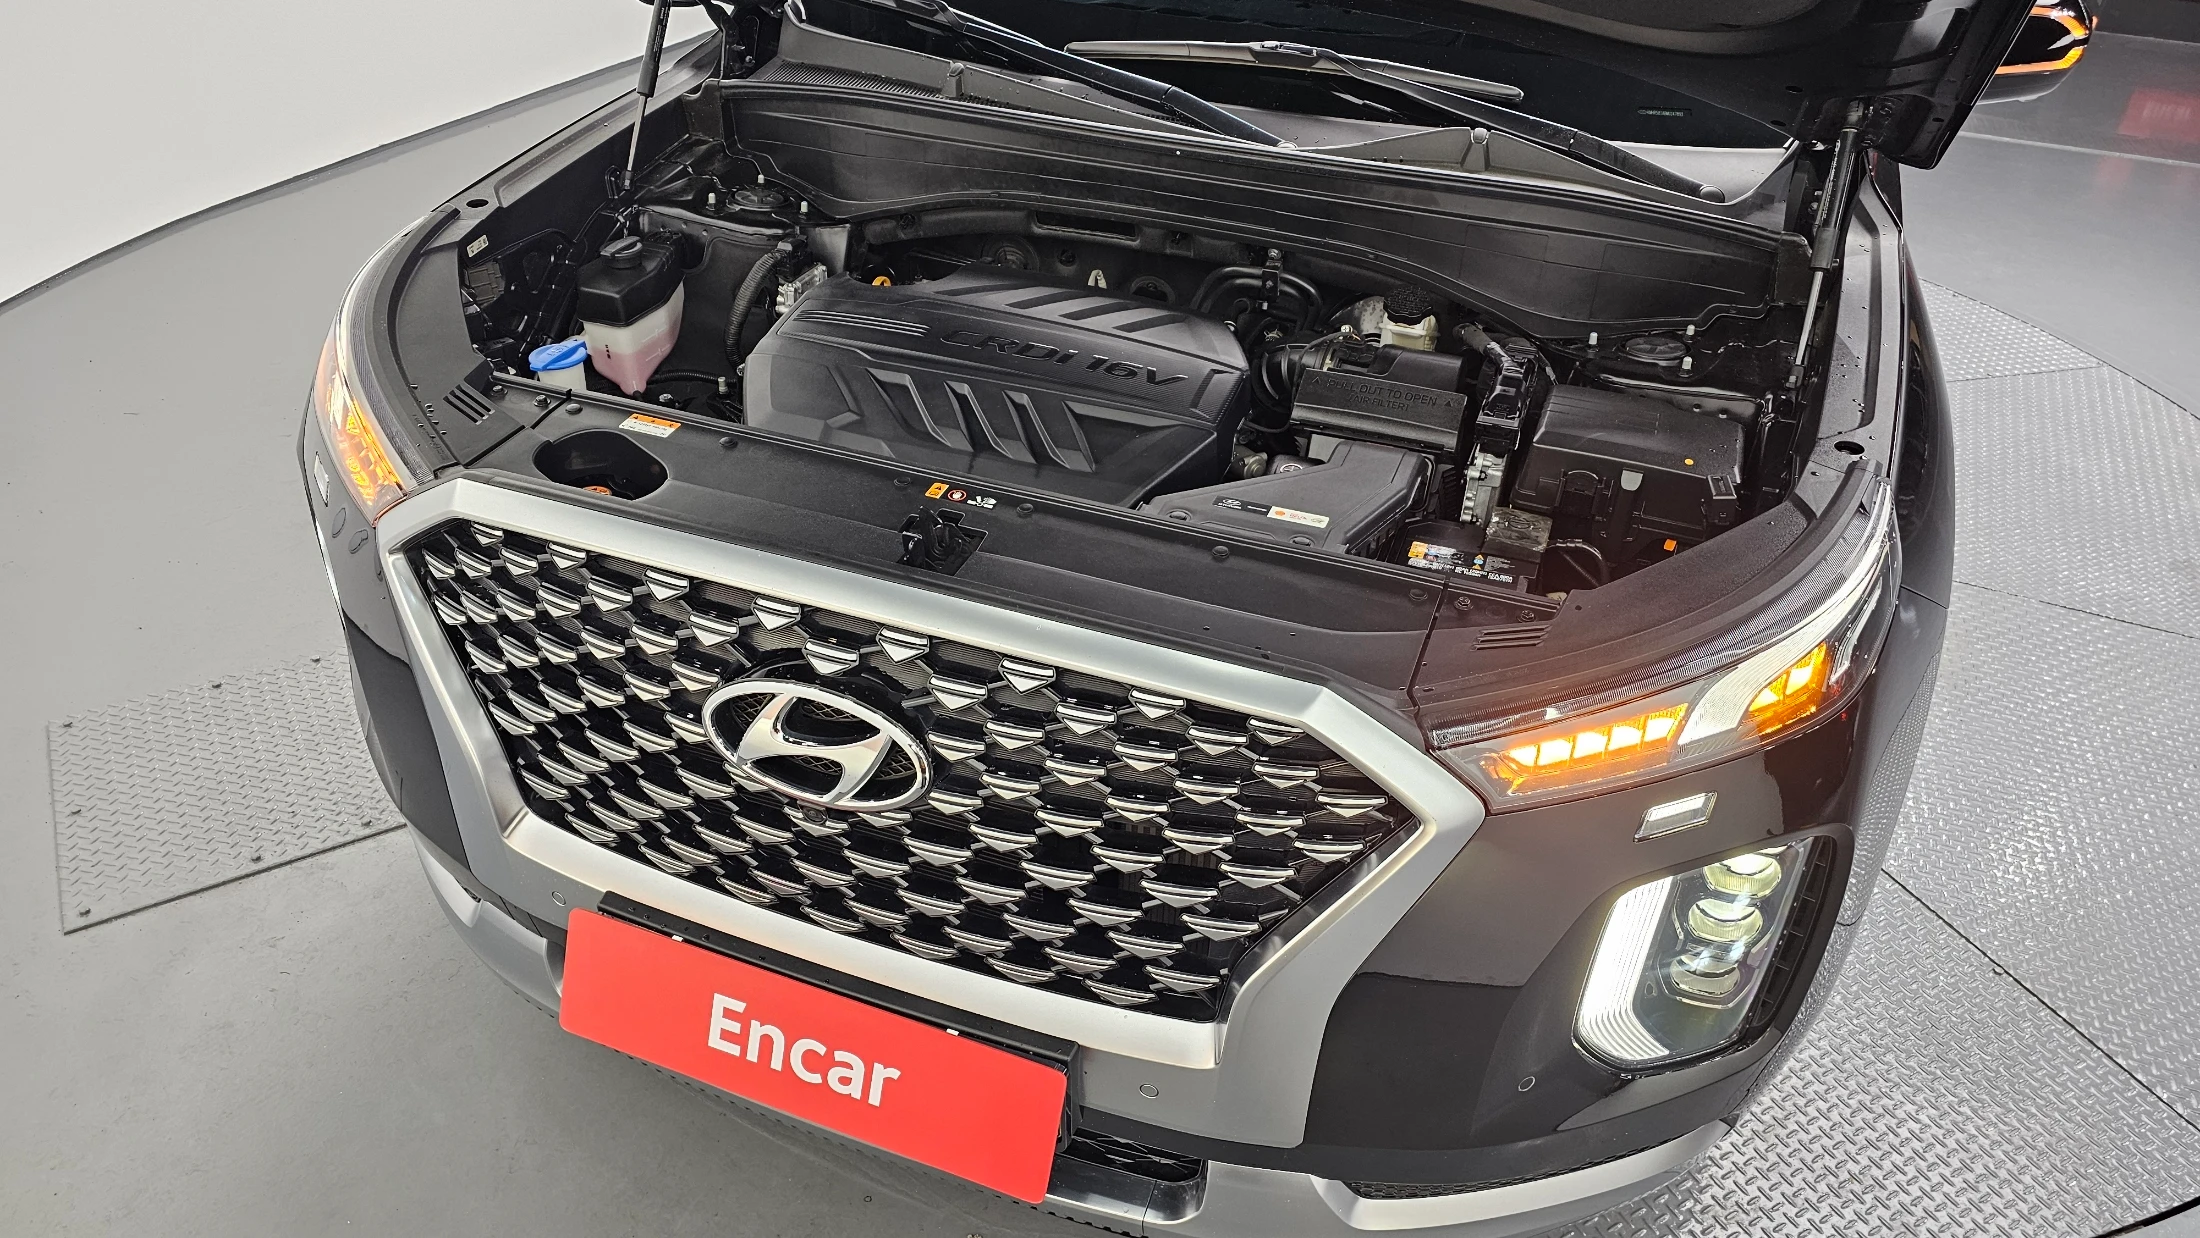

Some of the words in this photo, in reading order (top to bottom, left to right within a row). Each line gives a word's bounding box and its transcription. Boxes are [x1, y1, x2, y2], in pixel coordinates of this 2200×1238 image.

[1085, 354, 1188, 386] 16V
[1327, 378, 1356, 391] PULL
[1359, 383, 1385, 396] OUT
[1387, 388, 1402, 399] TO
[1404, 391, 1438, 406] OPEN
[707, 992, 901, 1107] Encar
